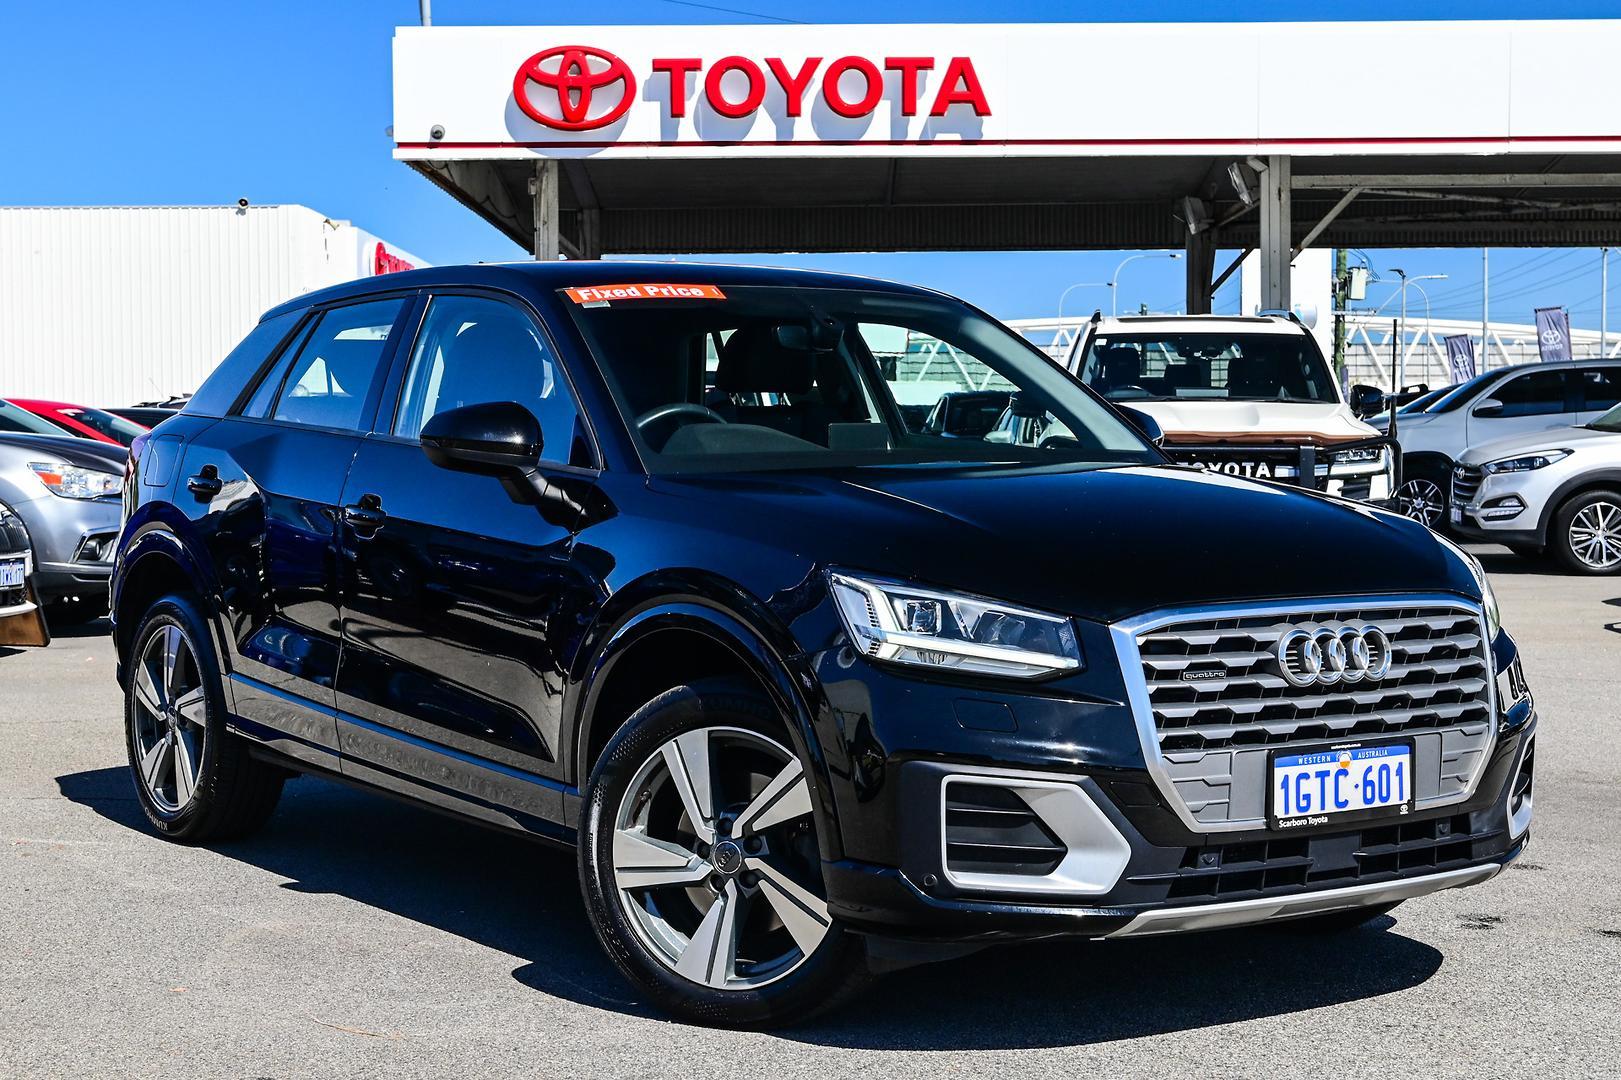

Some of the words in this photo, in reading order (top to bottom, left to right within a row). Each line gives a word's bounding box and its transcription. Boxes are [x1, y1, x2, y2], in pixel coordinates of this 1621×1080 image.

[652, 55, 992, 118] TOYOTA
[577, 286, 641, 300] Fixed
[643, 285, 705, 298] Price
[1185, 671, 1225, 680] quattro
[1298, 755, 1331, 765] WESTERN
[1357, 749, 1388, 759] AUSTRALIA
[1278, 817, 1307, 828] Scarboro
[1308, 815, 1329, 826] Toyota
